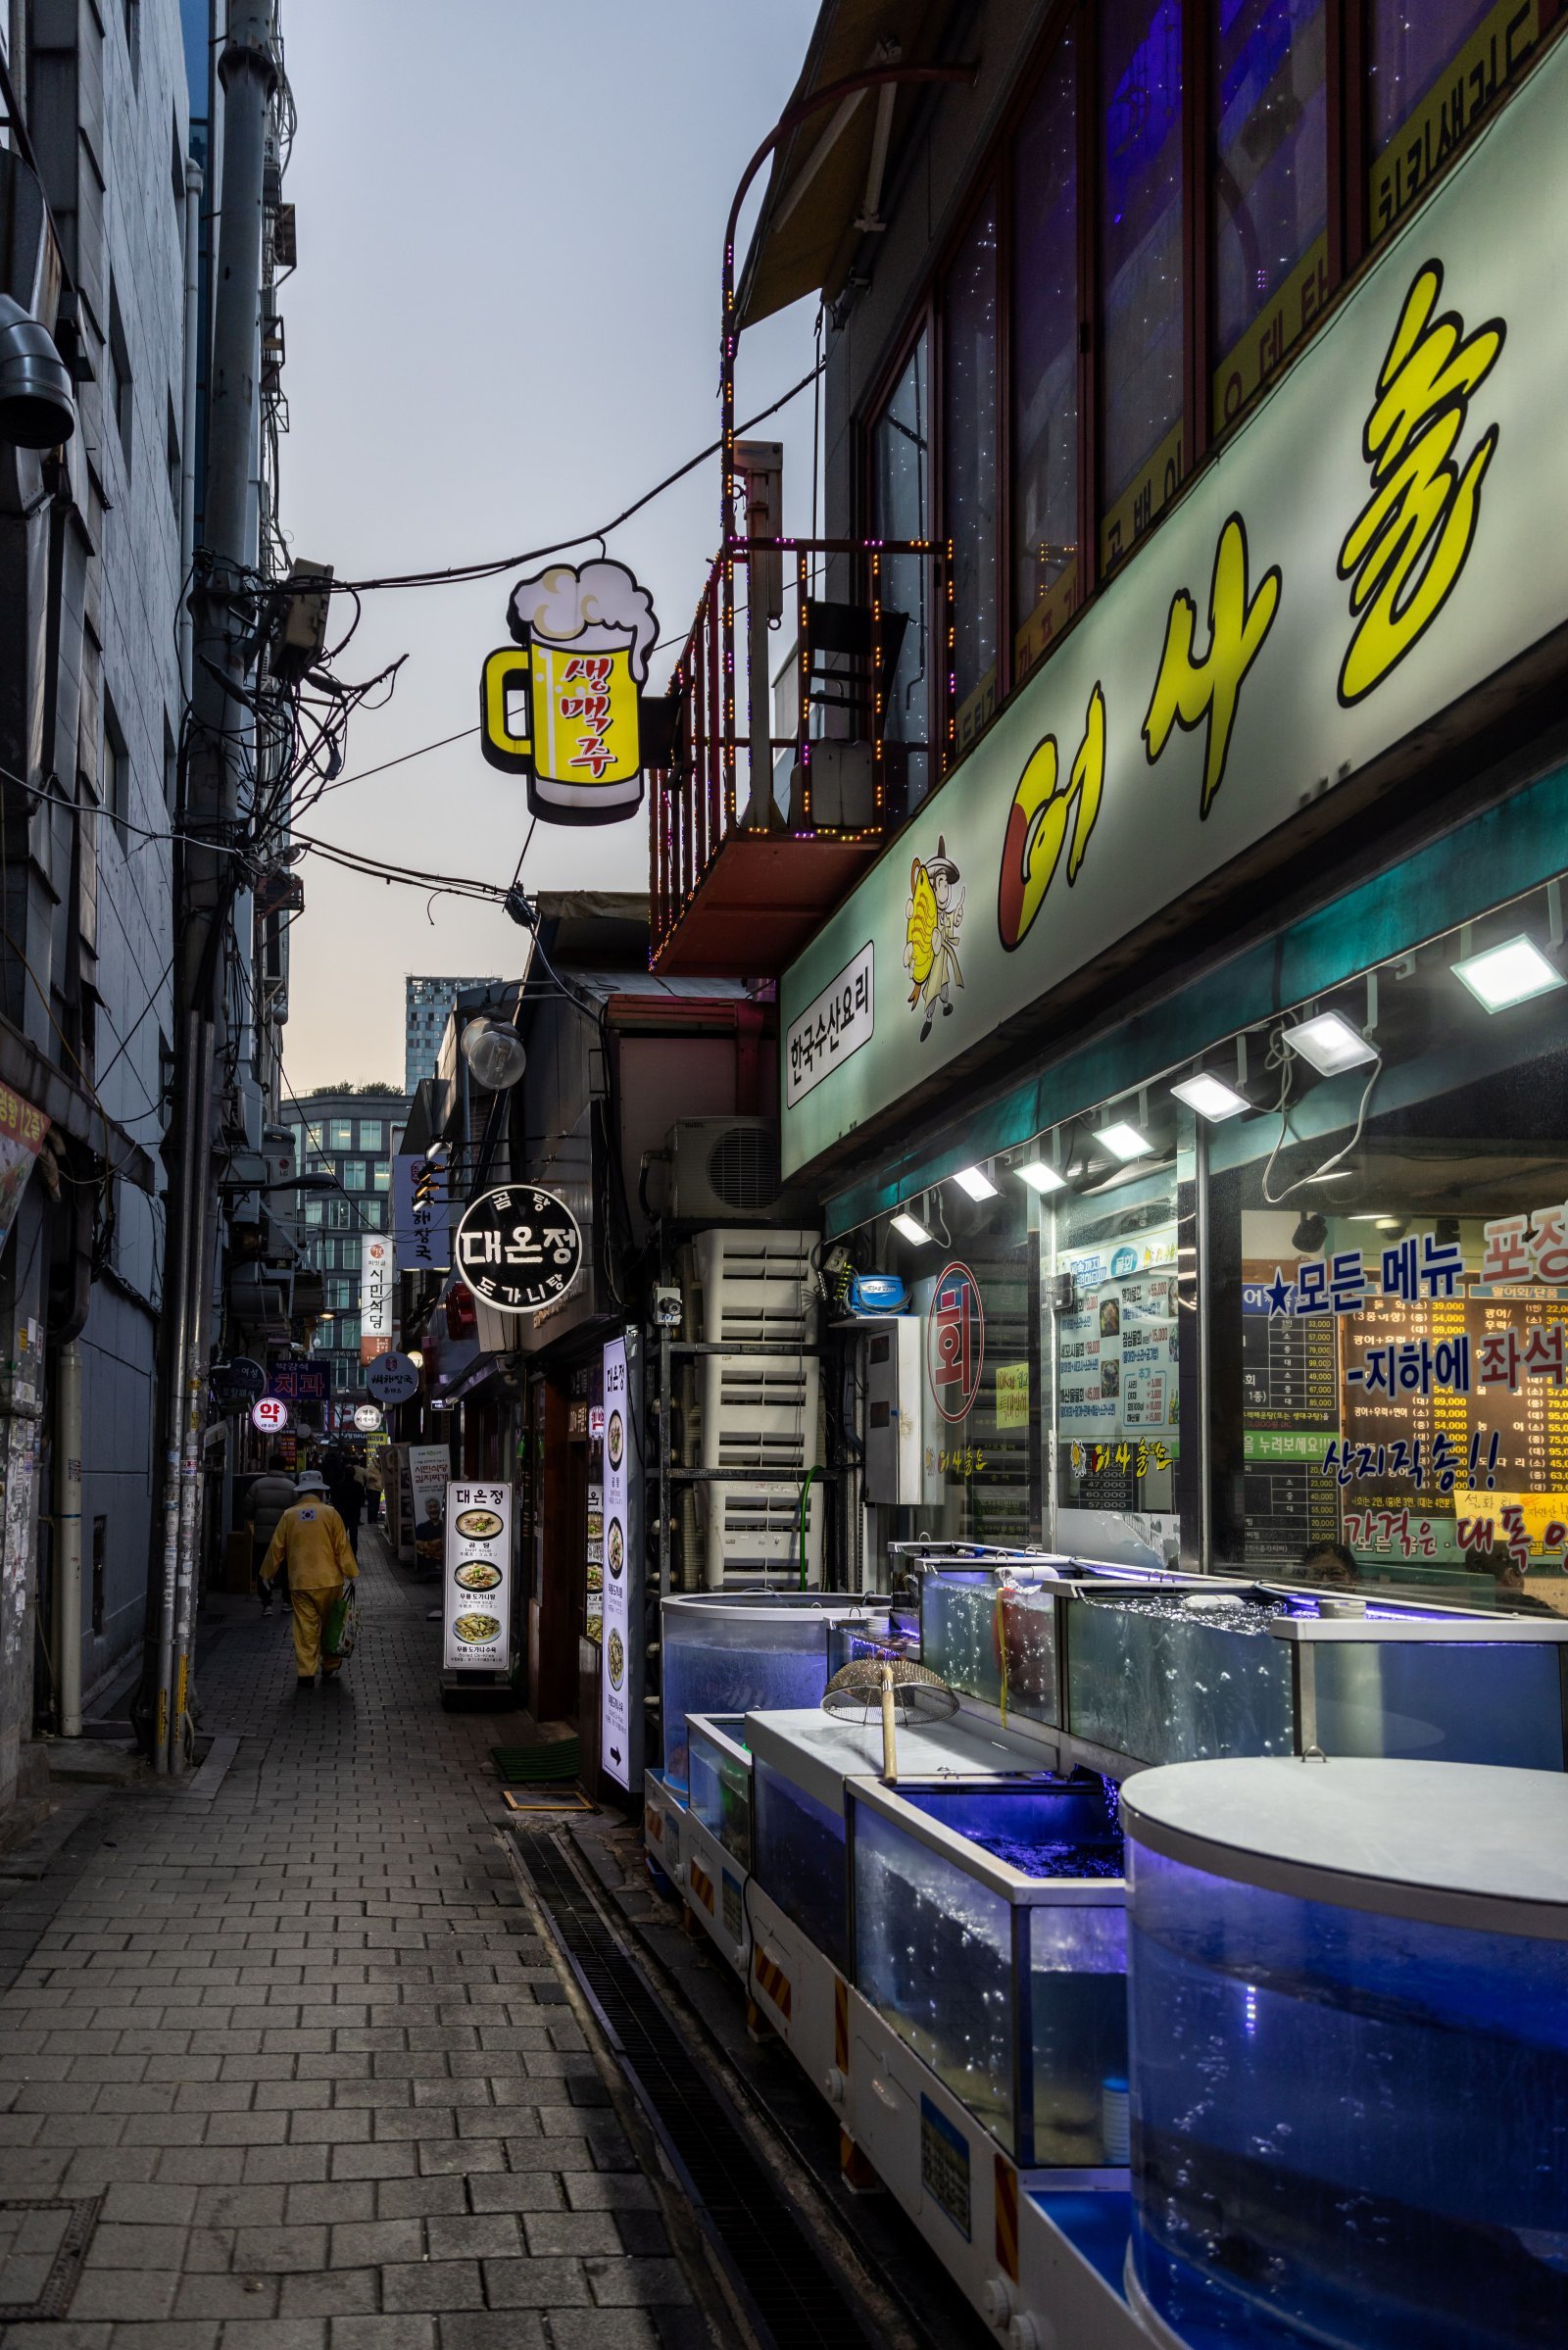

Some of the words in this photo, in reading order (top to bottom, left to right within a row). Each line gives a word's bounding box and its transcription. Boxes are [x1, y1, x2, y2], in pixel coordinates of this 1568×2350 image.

[561, 657, 617, 779] 생맥주
[790, 966, 869, 1087] 한국수산요리
[491, 1191, 551, 1211] 곰탕
[460, 1226, 576, 1265] 대온정
[1296, 1251, 1366, 1315] 모든
[1382, 1235, 1463, 1298] 메뉴
[369, 1269, 383, 1329] 시민식당
[476, 1273, 564, 1304] 도가니탕
[1432, 1301, 1465, 1310] 39,000
[1432, 1313, 1465, 1323] 54,000
[1411, 1325, 1428, 1334] (대)
[1432, 1325, 1465, 1334] 69,000
[1481, 1325, 1564, 1390] 좌석
[274, 1372, 325, 1397] 치과
[607, 1364, 625, 1393] 대온정
[260, 1403, 280, 1423] 약
[1412, 1408, 1429, 1417] (소)
[1434, 1409, 1467, 1418] 39,000
[1434, 1397, 1466, 1406] 69,000
[1434, 1421, 1467, 1430] 54,000
[457, 1489, 504, 1505] 대온정
[1345, 1509, 1435, 1556] 가격은
[1456, 1507, 1533, 1570] 대폭
